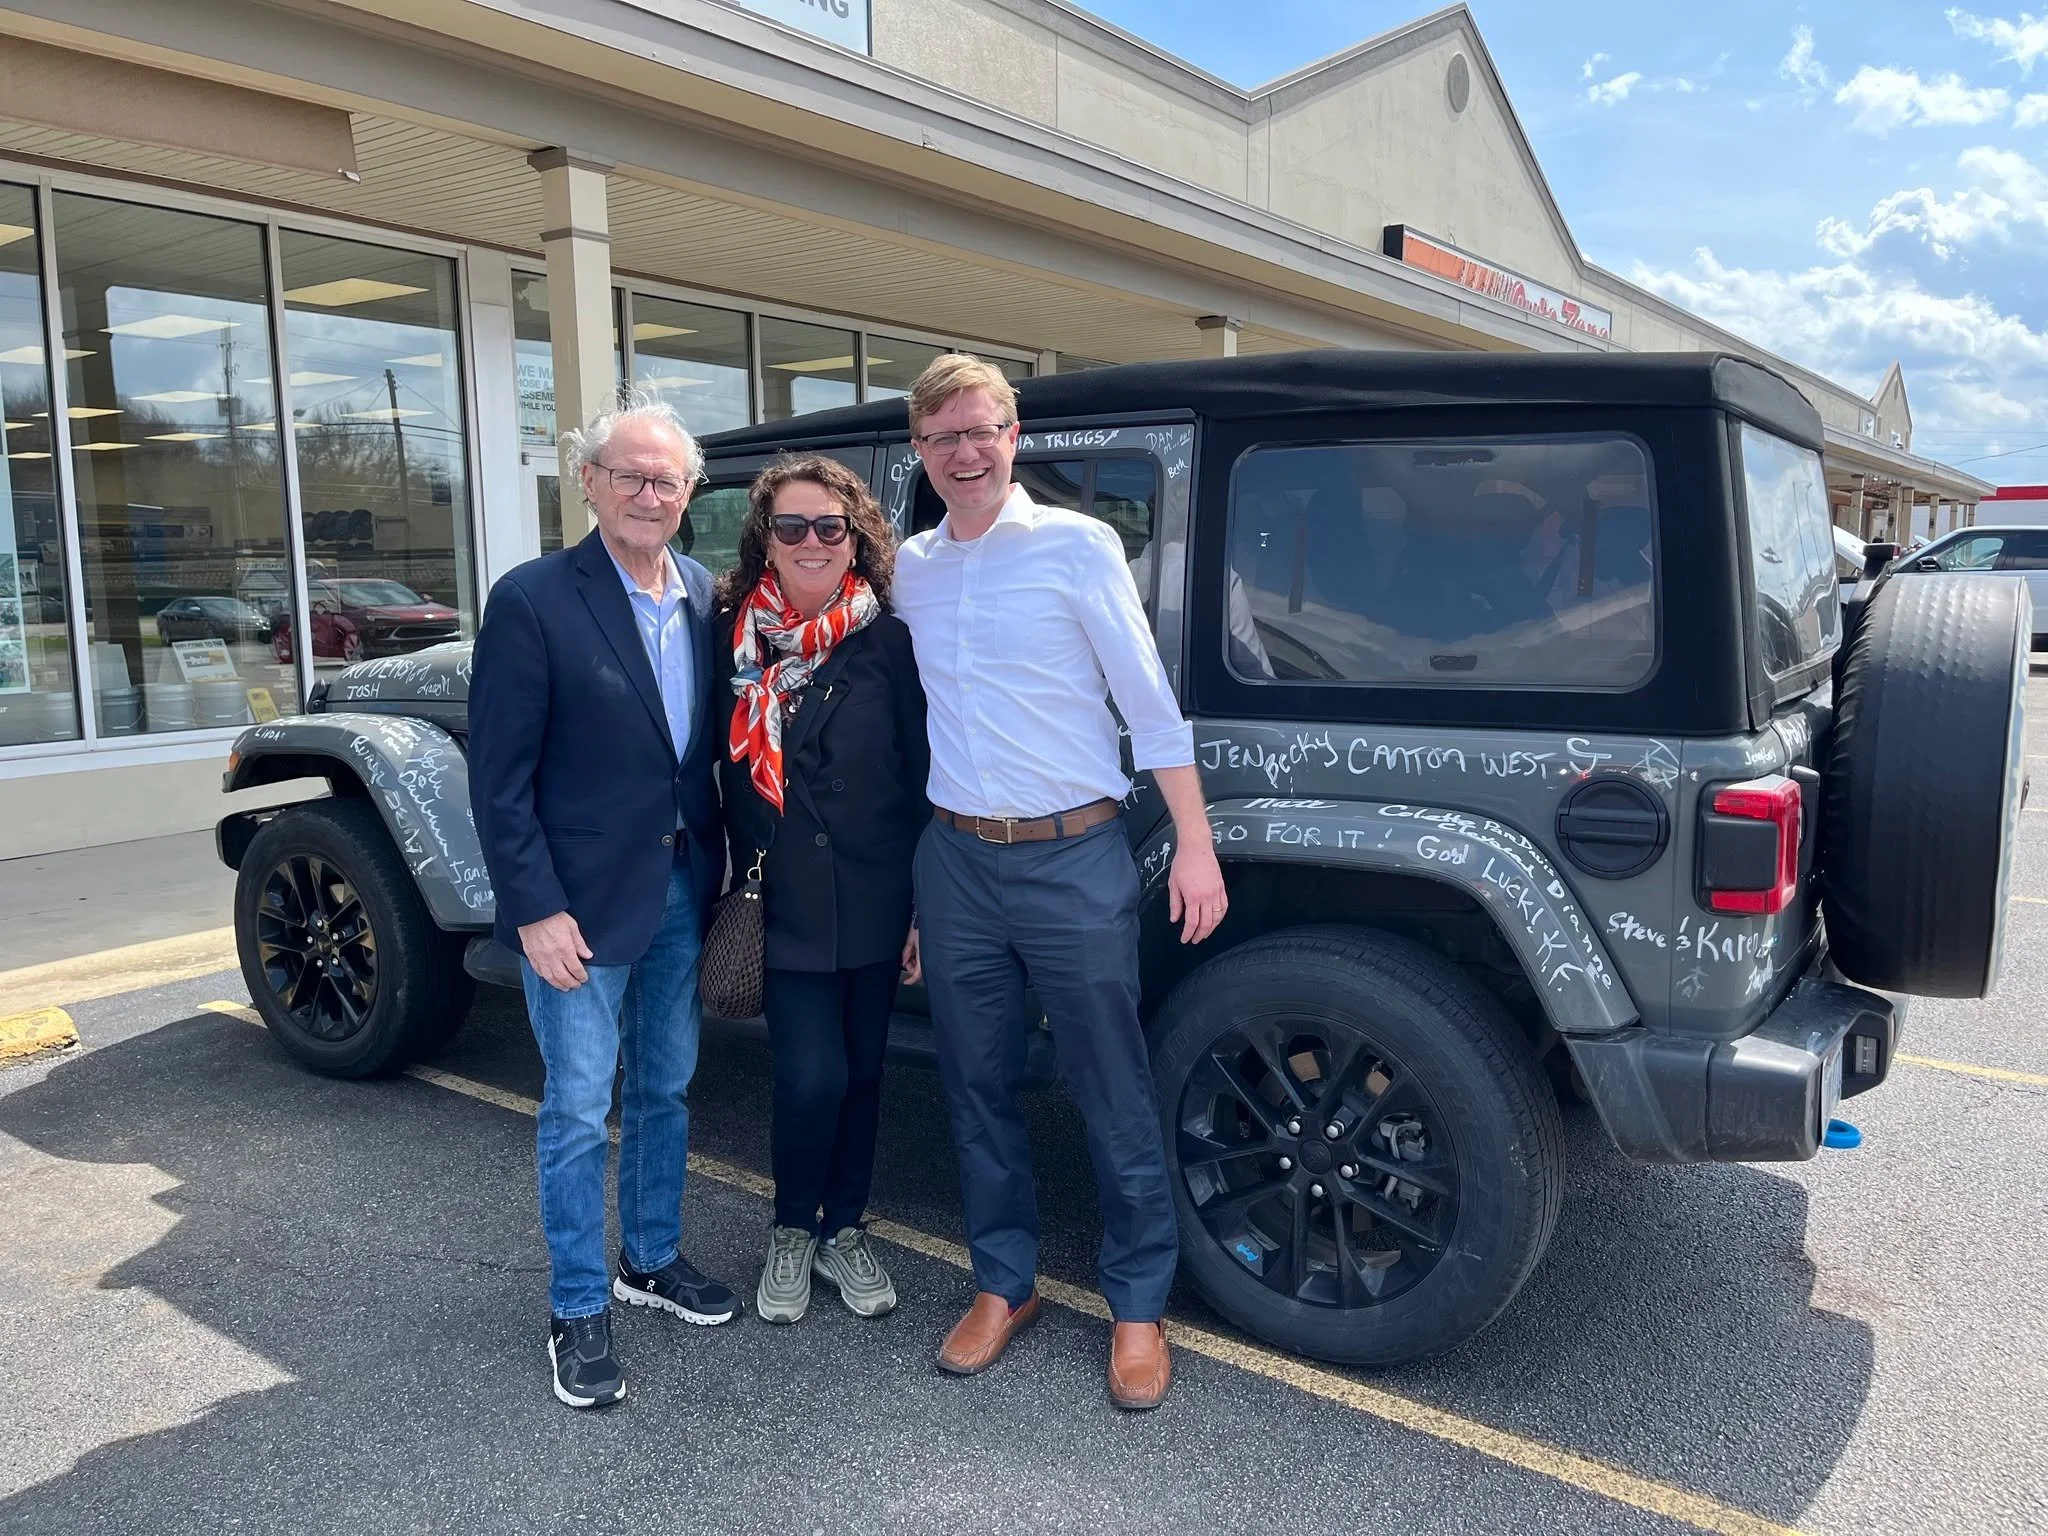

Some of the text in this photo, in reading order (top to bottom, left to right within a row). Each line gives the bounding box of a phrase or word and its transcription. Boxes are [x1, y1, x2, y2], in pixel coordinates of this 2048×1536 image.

[1044, 430, 1105, 449] TRIGGS
[347, 682, 381, 700] JOSH
[1200, 739, 1264, 770] JEN
[1480, 750, 1557, 780] WEST
[1265, 822, 1322, 847] FOR
[1337, 829, 1365, 849] IT
[1606, 911, 1668, 949] Steve
[1696, 921, 1760, 963] Karen
